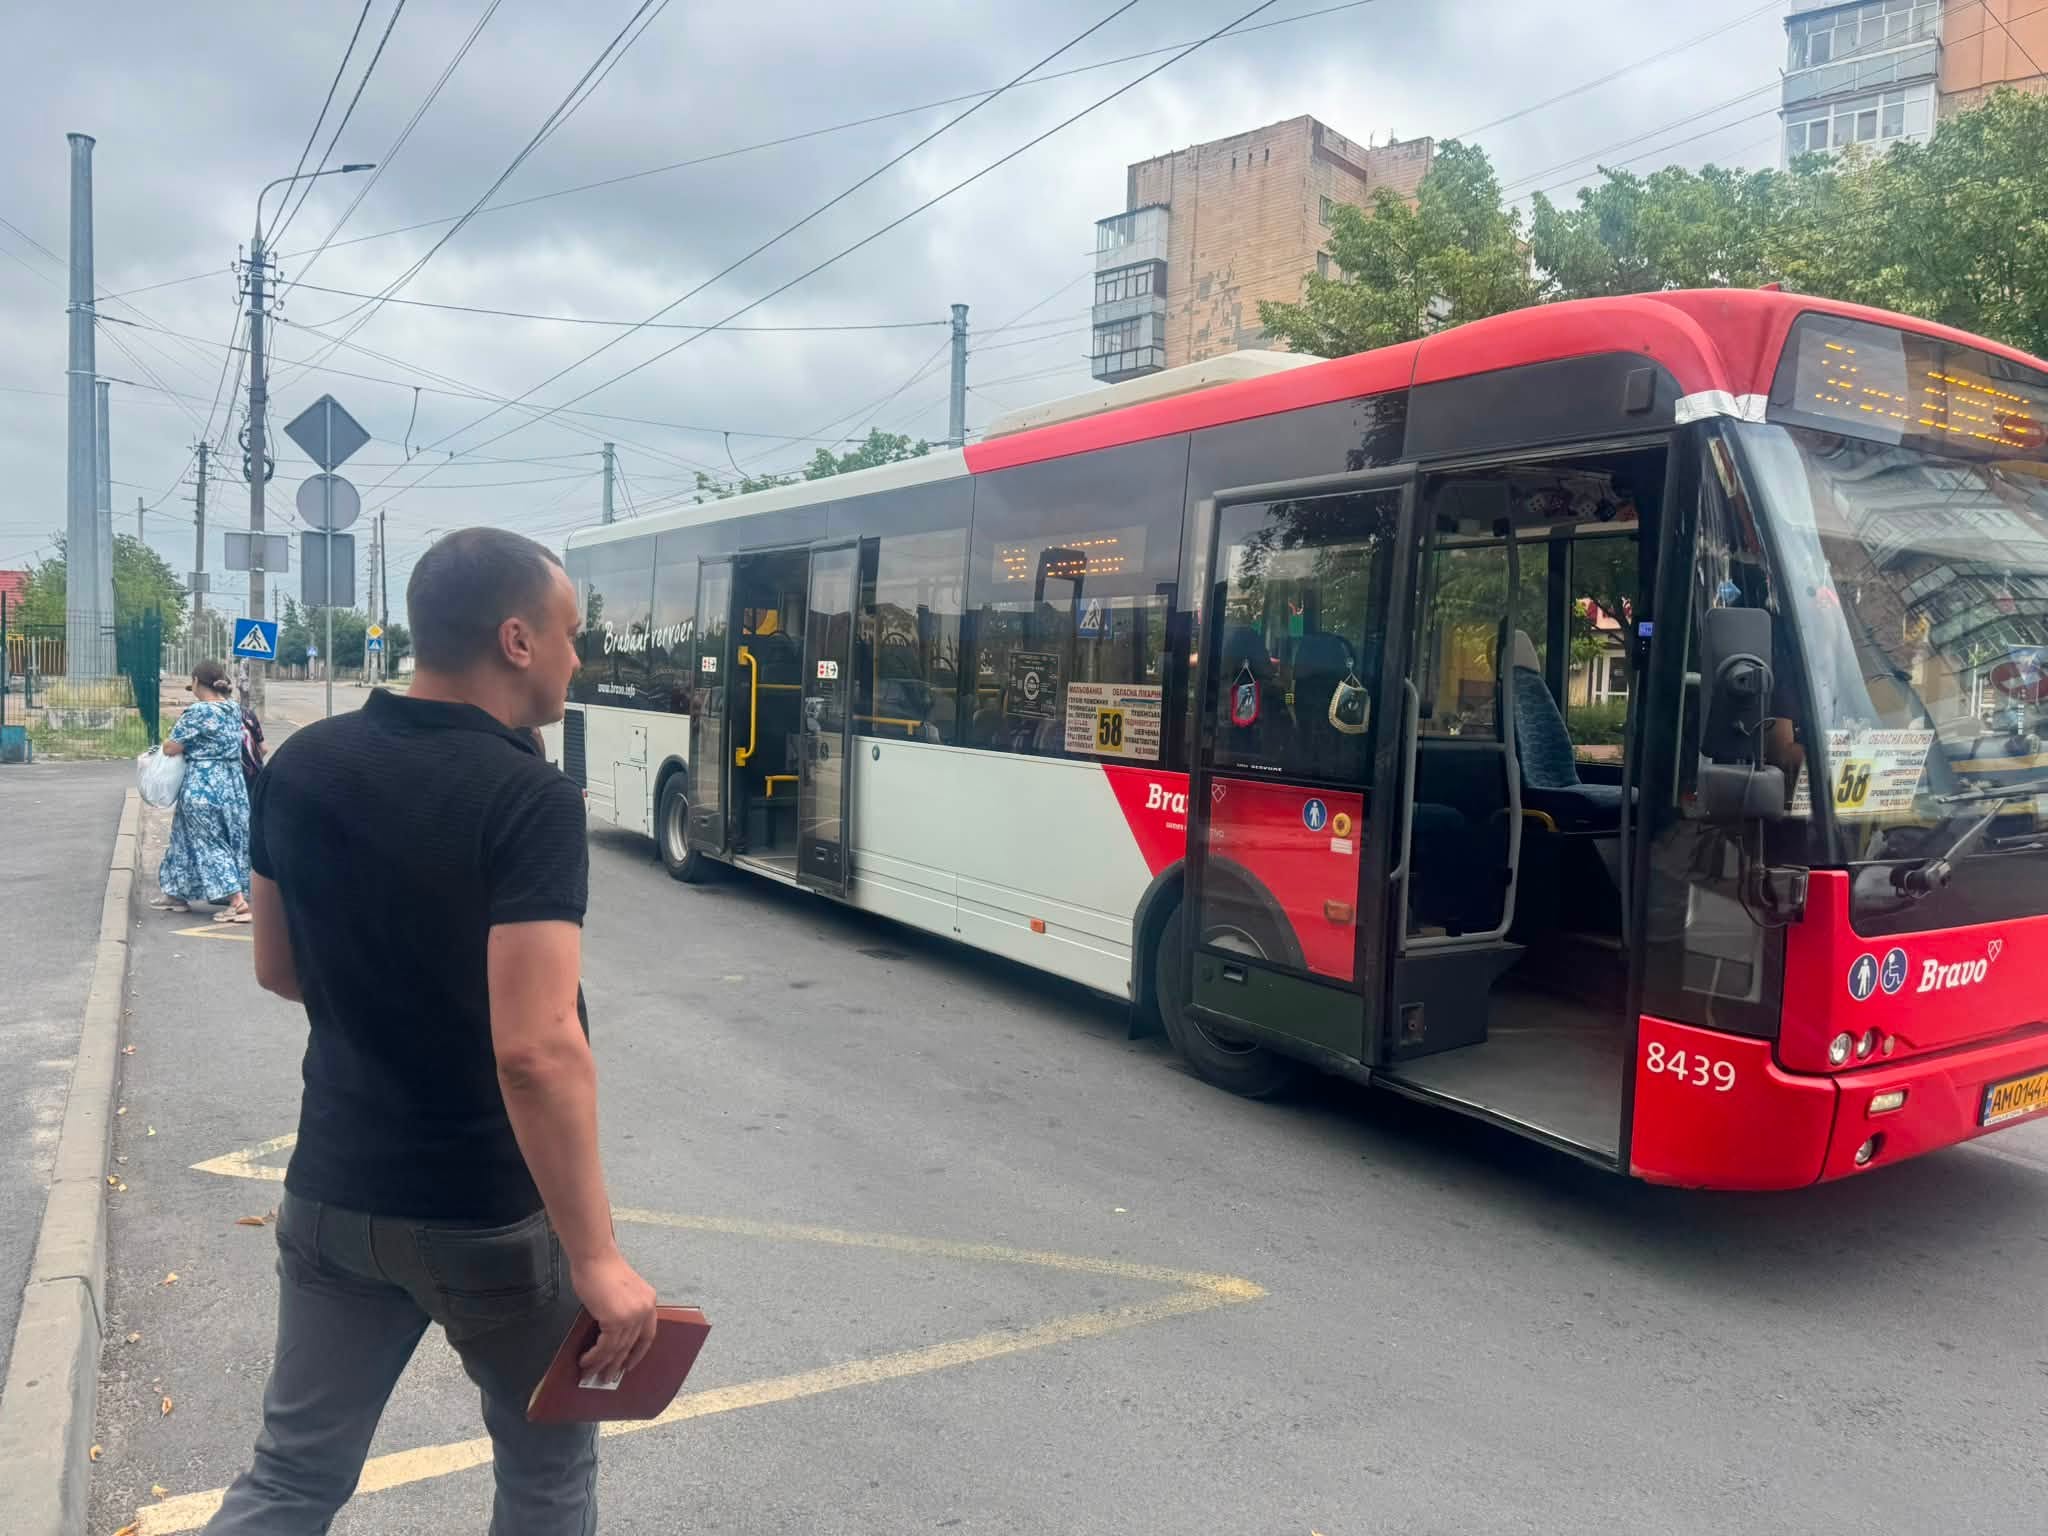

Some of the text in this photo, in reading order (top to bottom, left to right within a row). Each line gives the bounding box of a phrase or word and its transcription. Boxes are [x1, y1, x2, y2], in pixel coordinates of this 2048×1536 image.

[603, 620, 650, 655] Brabant
[1099, 713, 1122, 747] 58
[1145, 783, 1189, 814] Bra
[1837, 763, 1871, 803] 58
[1917, 956, 1988, 992] Bravo
[1646, 1041, 1736, 1092] 8439
